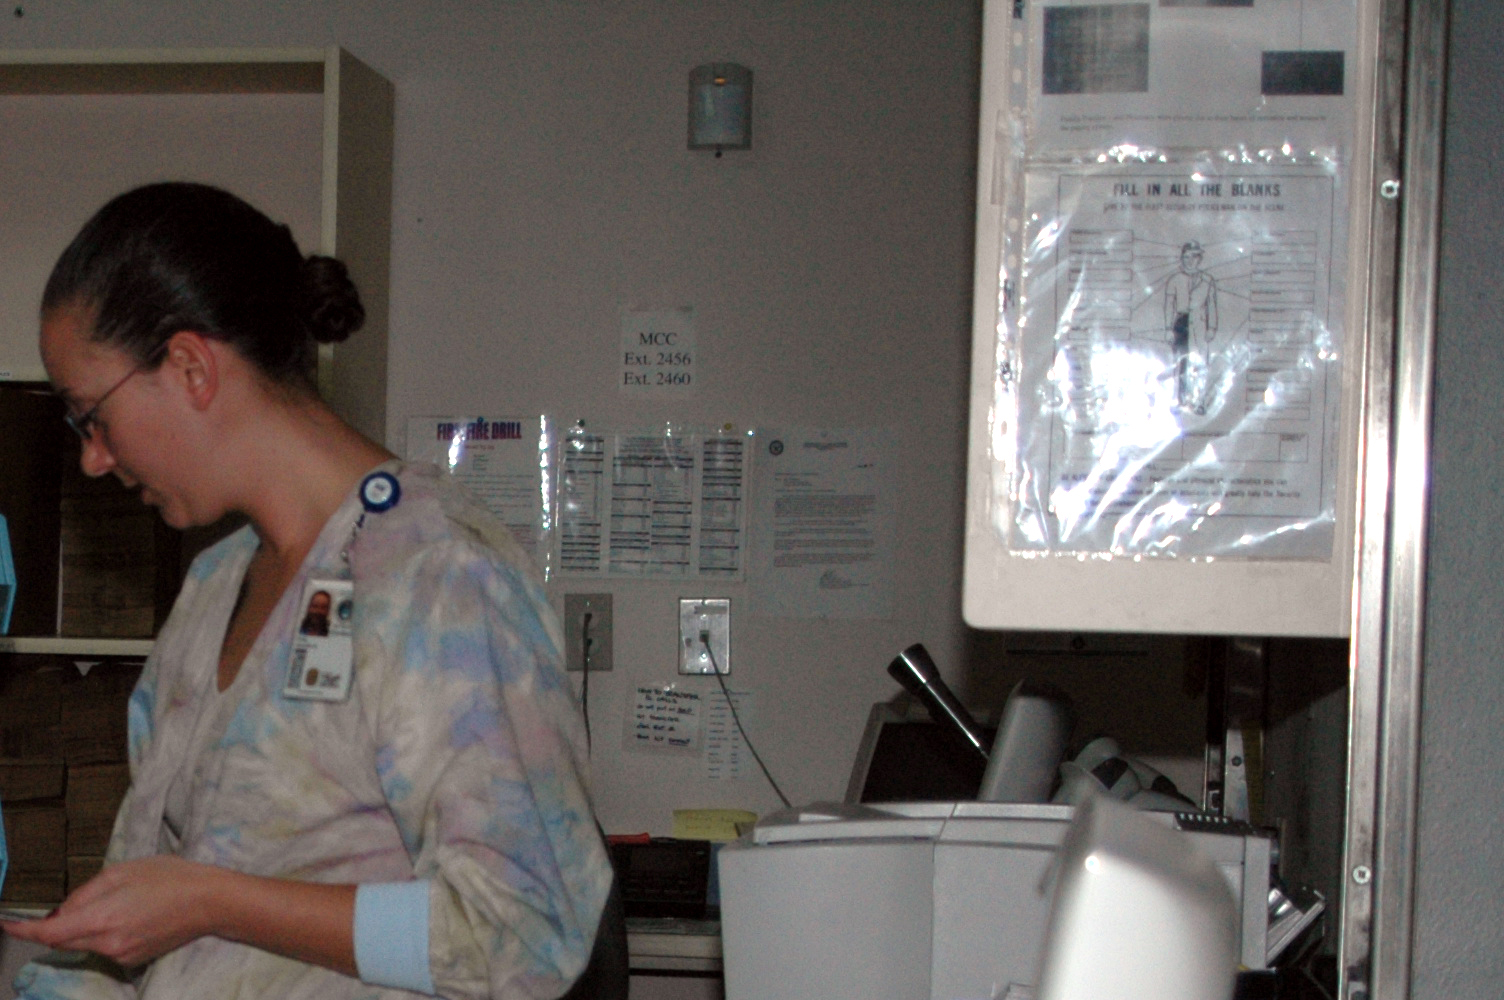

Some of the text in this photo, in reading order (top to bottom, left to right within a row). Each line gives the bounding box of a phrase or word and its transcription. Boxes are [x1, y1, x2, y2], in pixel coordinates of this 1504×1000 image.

[1113, 183, 1281, 198] FILL IN ALL THE BLANKS
[639, 332, 677, 346] MCC
[624, 352, 691, 366] Ext. 2456
[624, 372, 691, 386] Ext. 2460
[437, 421, 522, 440] FIR FIRE DRILL
